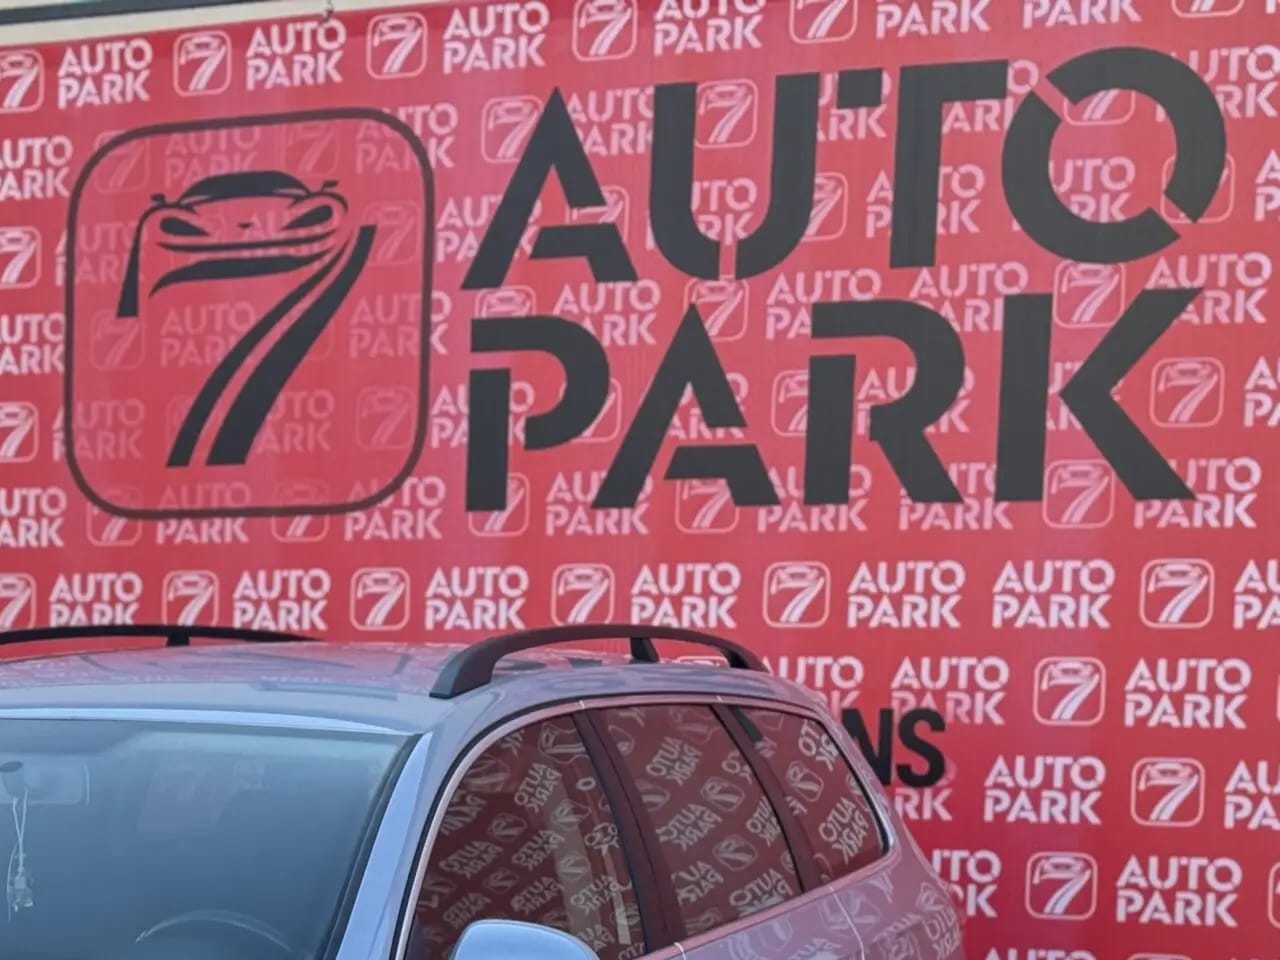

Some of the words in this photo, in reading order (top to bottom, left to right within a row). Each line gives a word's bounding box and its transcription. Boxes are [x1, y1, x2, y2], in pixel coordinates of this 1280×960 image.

[444, 1, 548, 39] AUTO
[655, 15, 763, 55] PARK
[876, 2, 990, 39] PARK
[247, 20, 346, 58] AUTO
[444, 34, 545, 73] PARK
[58, 38, 151, 76] AUTO
[247, 51, 342, 90] PARK
[1188, 45, 1280, 83] UTO
[58, 70, 149, 108] PARK
[461, 46, 1227, 289] AUTO
[1048, 157, 1136, 194] UTO
[767, 268, 882, 304] AUTO
[910, 262, 1028, 299] AUTO
[1145, 252, 1272, 289] AUTO
[553, 279, 661, 316] AUTO
[465, 286, 1203, 512] PARK
[344, 508, 442, 542] PARK
[546, 503, 650, 536] PARK
[757, 499, 869, 532] PARK
[899, 497, 1013, 531] PARK
[1134, 493, 1258, 528] PARK
[49, 572, 142, 604] AUTO
[233, 568, 330, 601] AUTO
[426, 566, 528, 598] AUTO
[631, 563, 741, 596] AUTO
[848, 560, 965, 595] AUTO
[993, 560, 1115, 593] AUTO
[50, 602, 138, 626] PARK
[235, 599, 326, 629] PARK
[427, 598, 525, 629] PARK
[631, 595, 736, 628] PARK
[848, 594, 961, 628] PARK
[992, 594, 1110, 628] PARK
[890, 656, 1010, 690] AUTO
[1125, 658, 1251, 693] AUTO
[1125, 691, 1247, 729] PARK
[841, 708, 947, 788] NS
[984, 756, 1106, 790] AUTO
[984, 789, 1101, 824] PARK
[1116, 856, 1242, 892] AUTO
[1116, 888, 1238, 927] PARK
